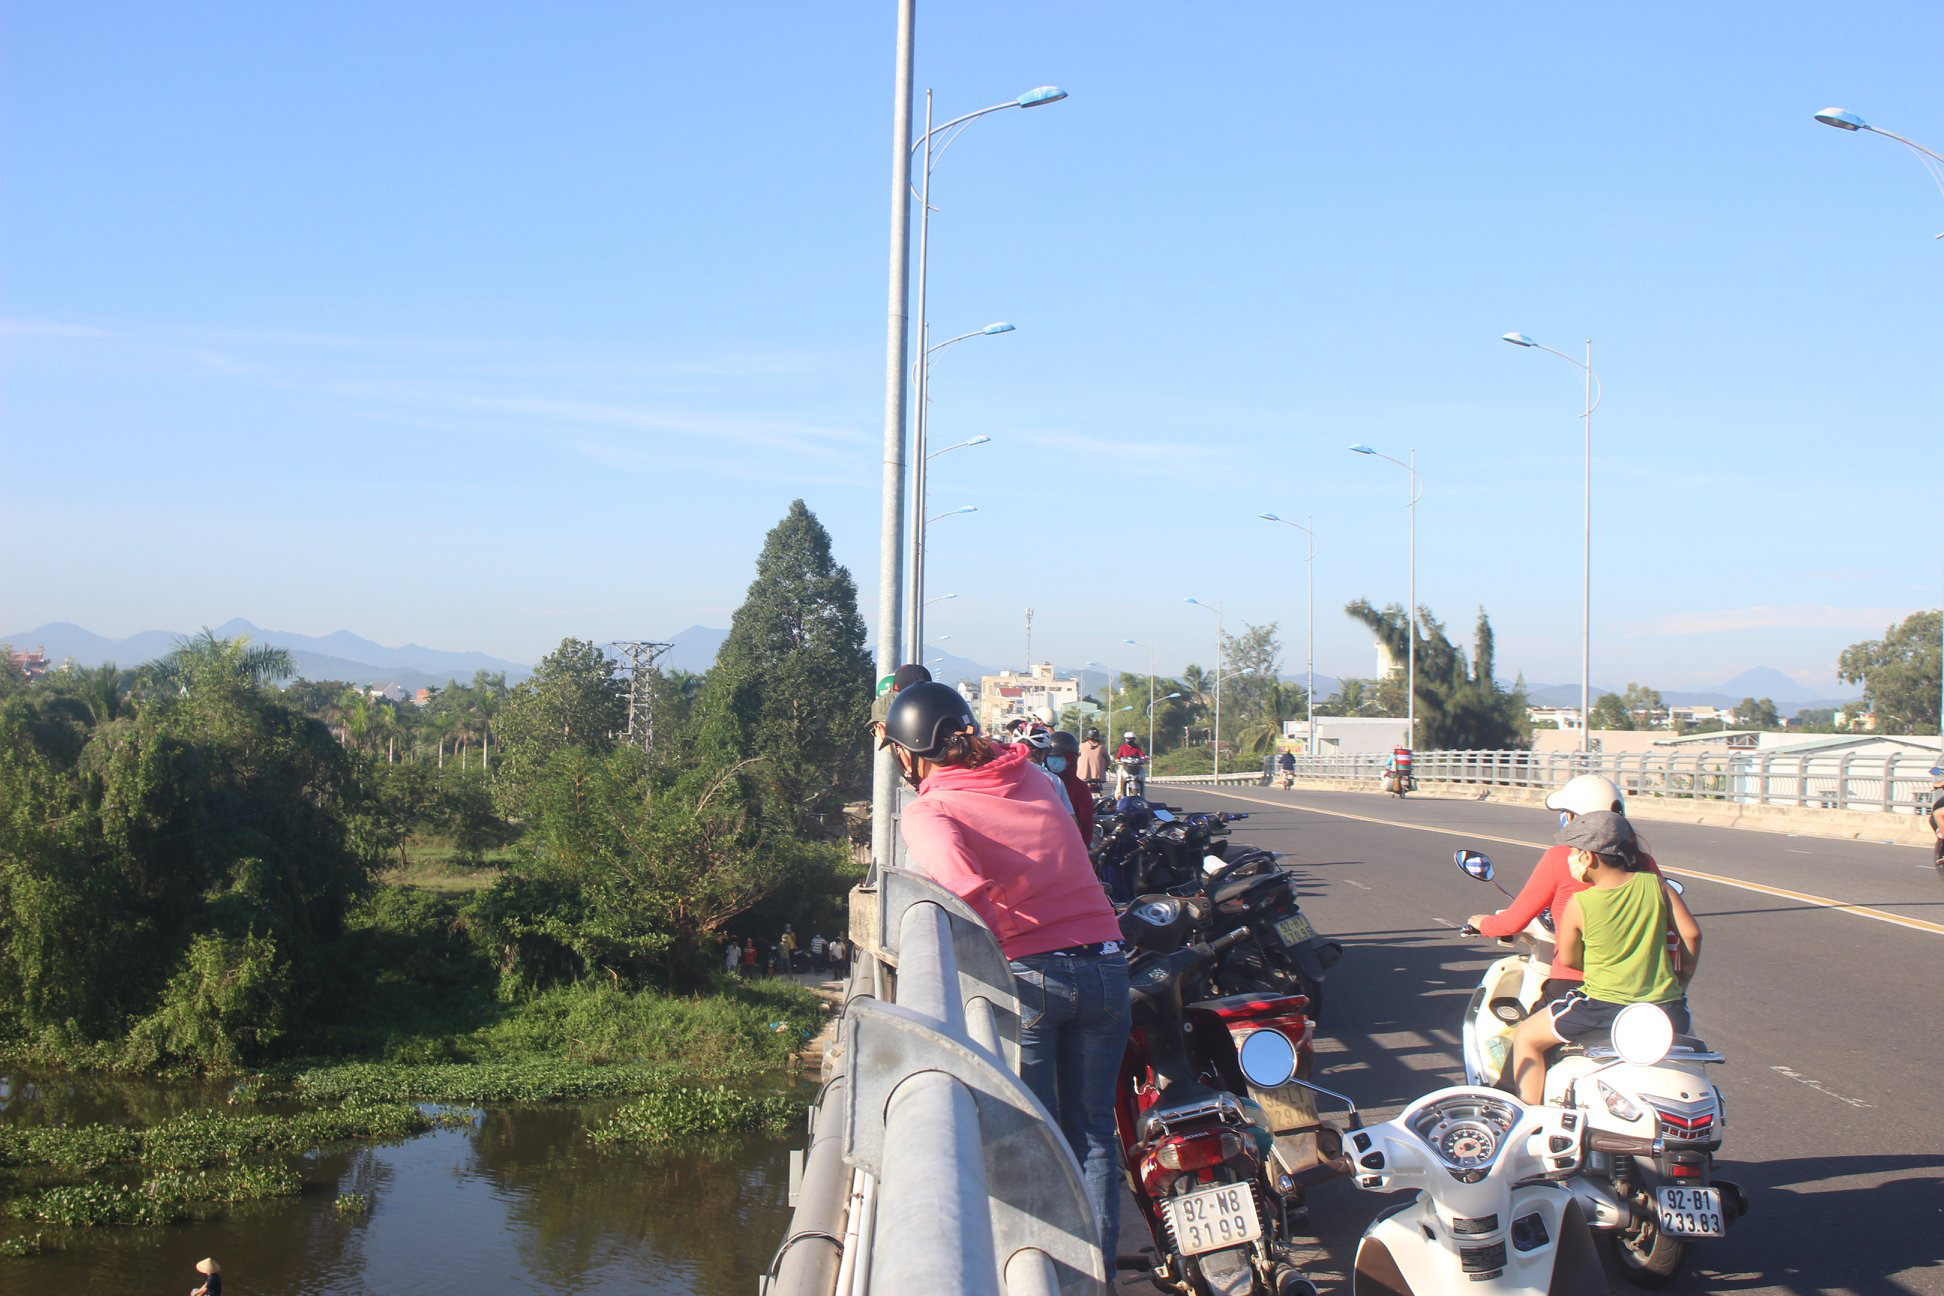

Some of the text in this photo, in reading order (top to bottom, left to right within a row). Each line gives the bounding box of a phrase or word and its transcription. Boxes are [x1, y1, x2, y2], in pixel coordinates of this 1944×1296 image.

[1667, 1189, 1710, 1211] 92-B1
[1189, 1215, 1248, 1249] 3199
[1664, 1212, 1720, 1233] 233.83
